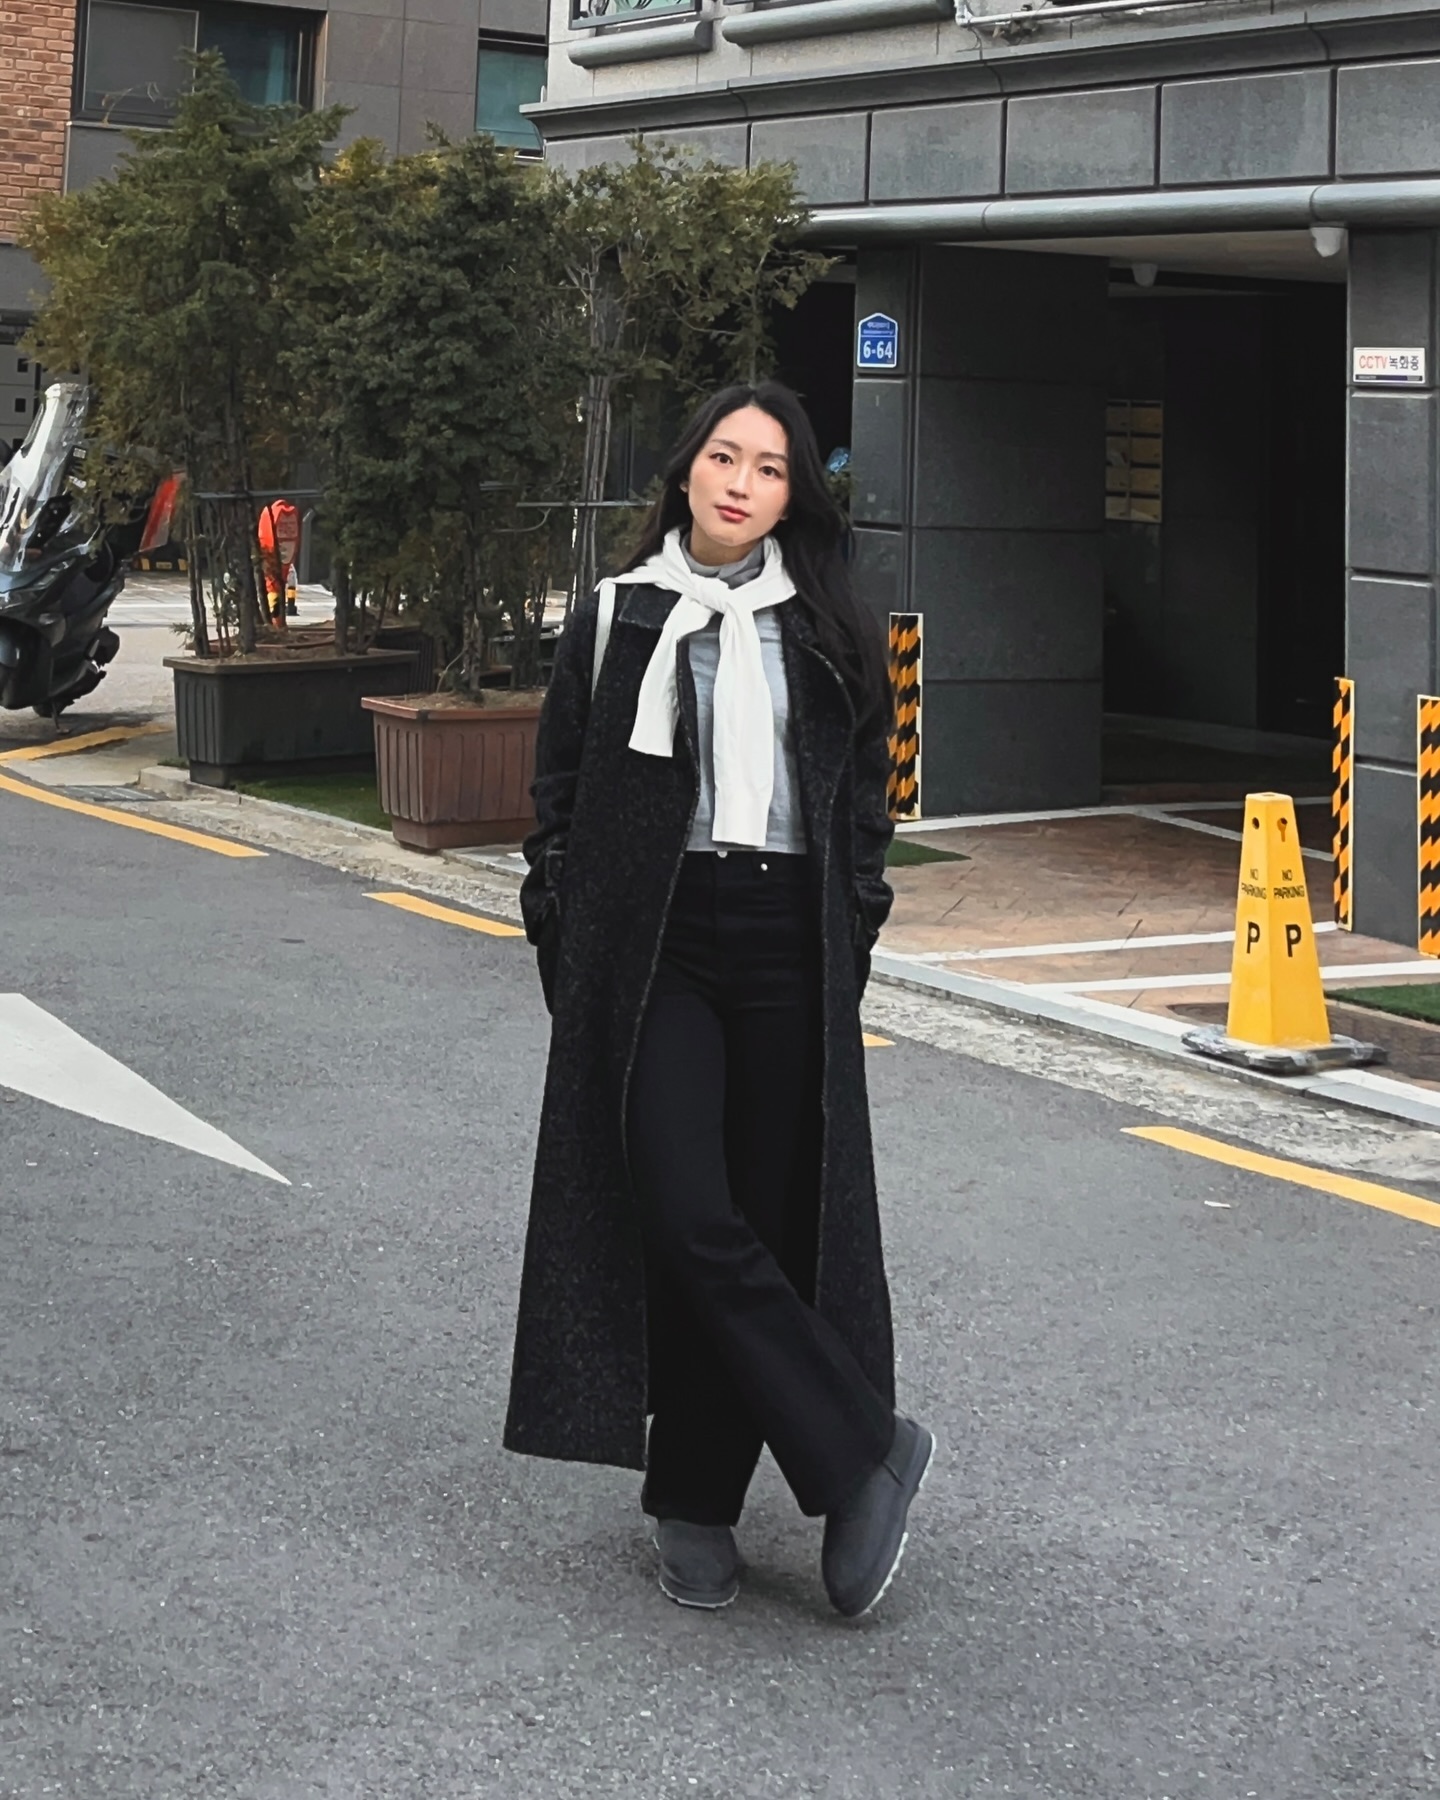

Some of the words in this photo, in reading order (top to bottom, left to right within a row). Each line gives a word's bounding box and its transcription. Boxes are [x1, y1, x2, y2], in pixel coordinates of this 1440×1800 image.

[863, 340, 893, 359] 6-64
[1359, 355, 1388, 369] CCTV
[1389, 355, 1419, 371] 녹화중
[1250, 868, 1259, 881] NO
[1281, 869, 1293, 881] NO
[1241, 882, 1267, 900] PARKING
[1273, 885, 1305, 899] PARKING
[1246, 921, 1260, 954] P
[1285, 924, 1302, 958] P
